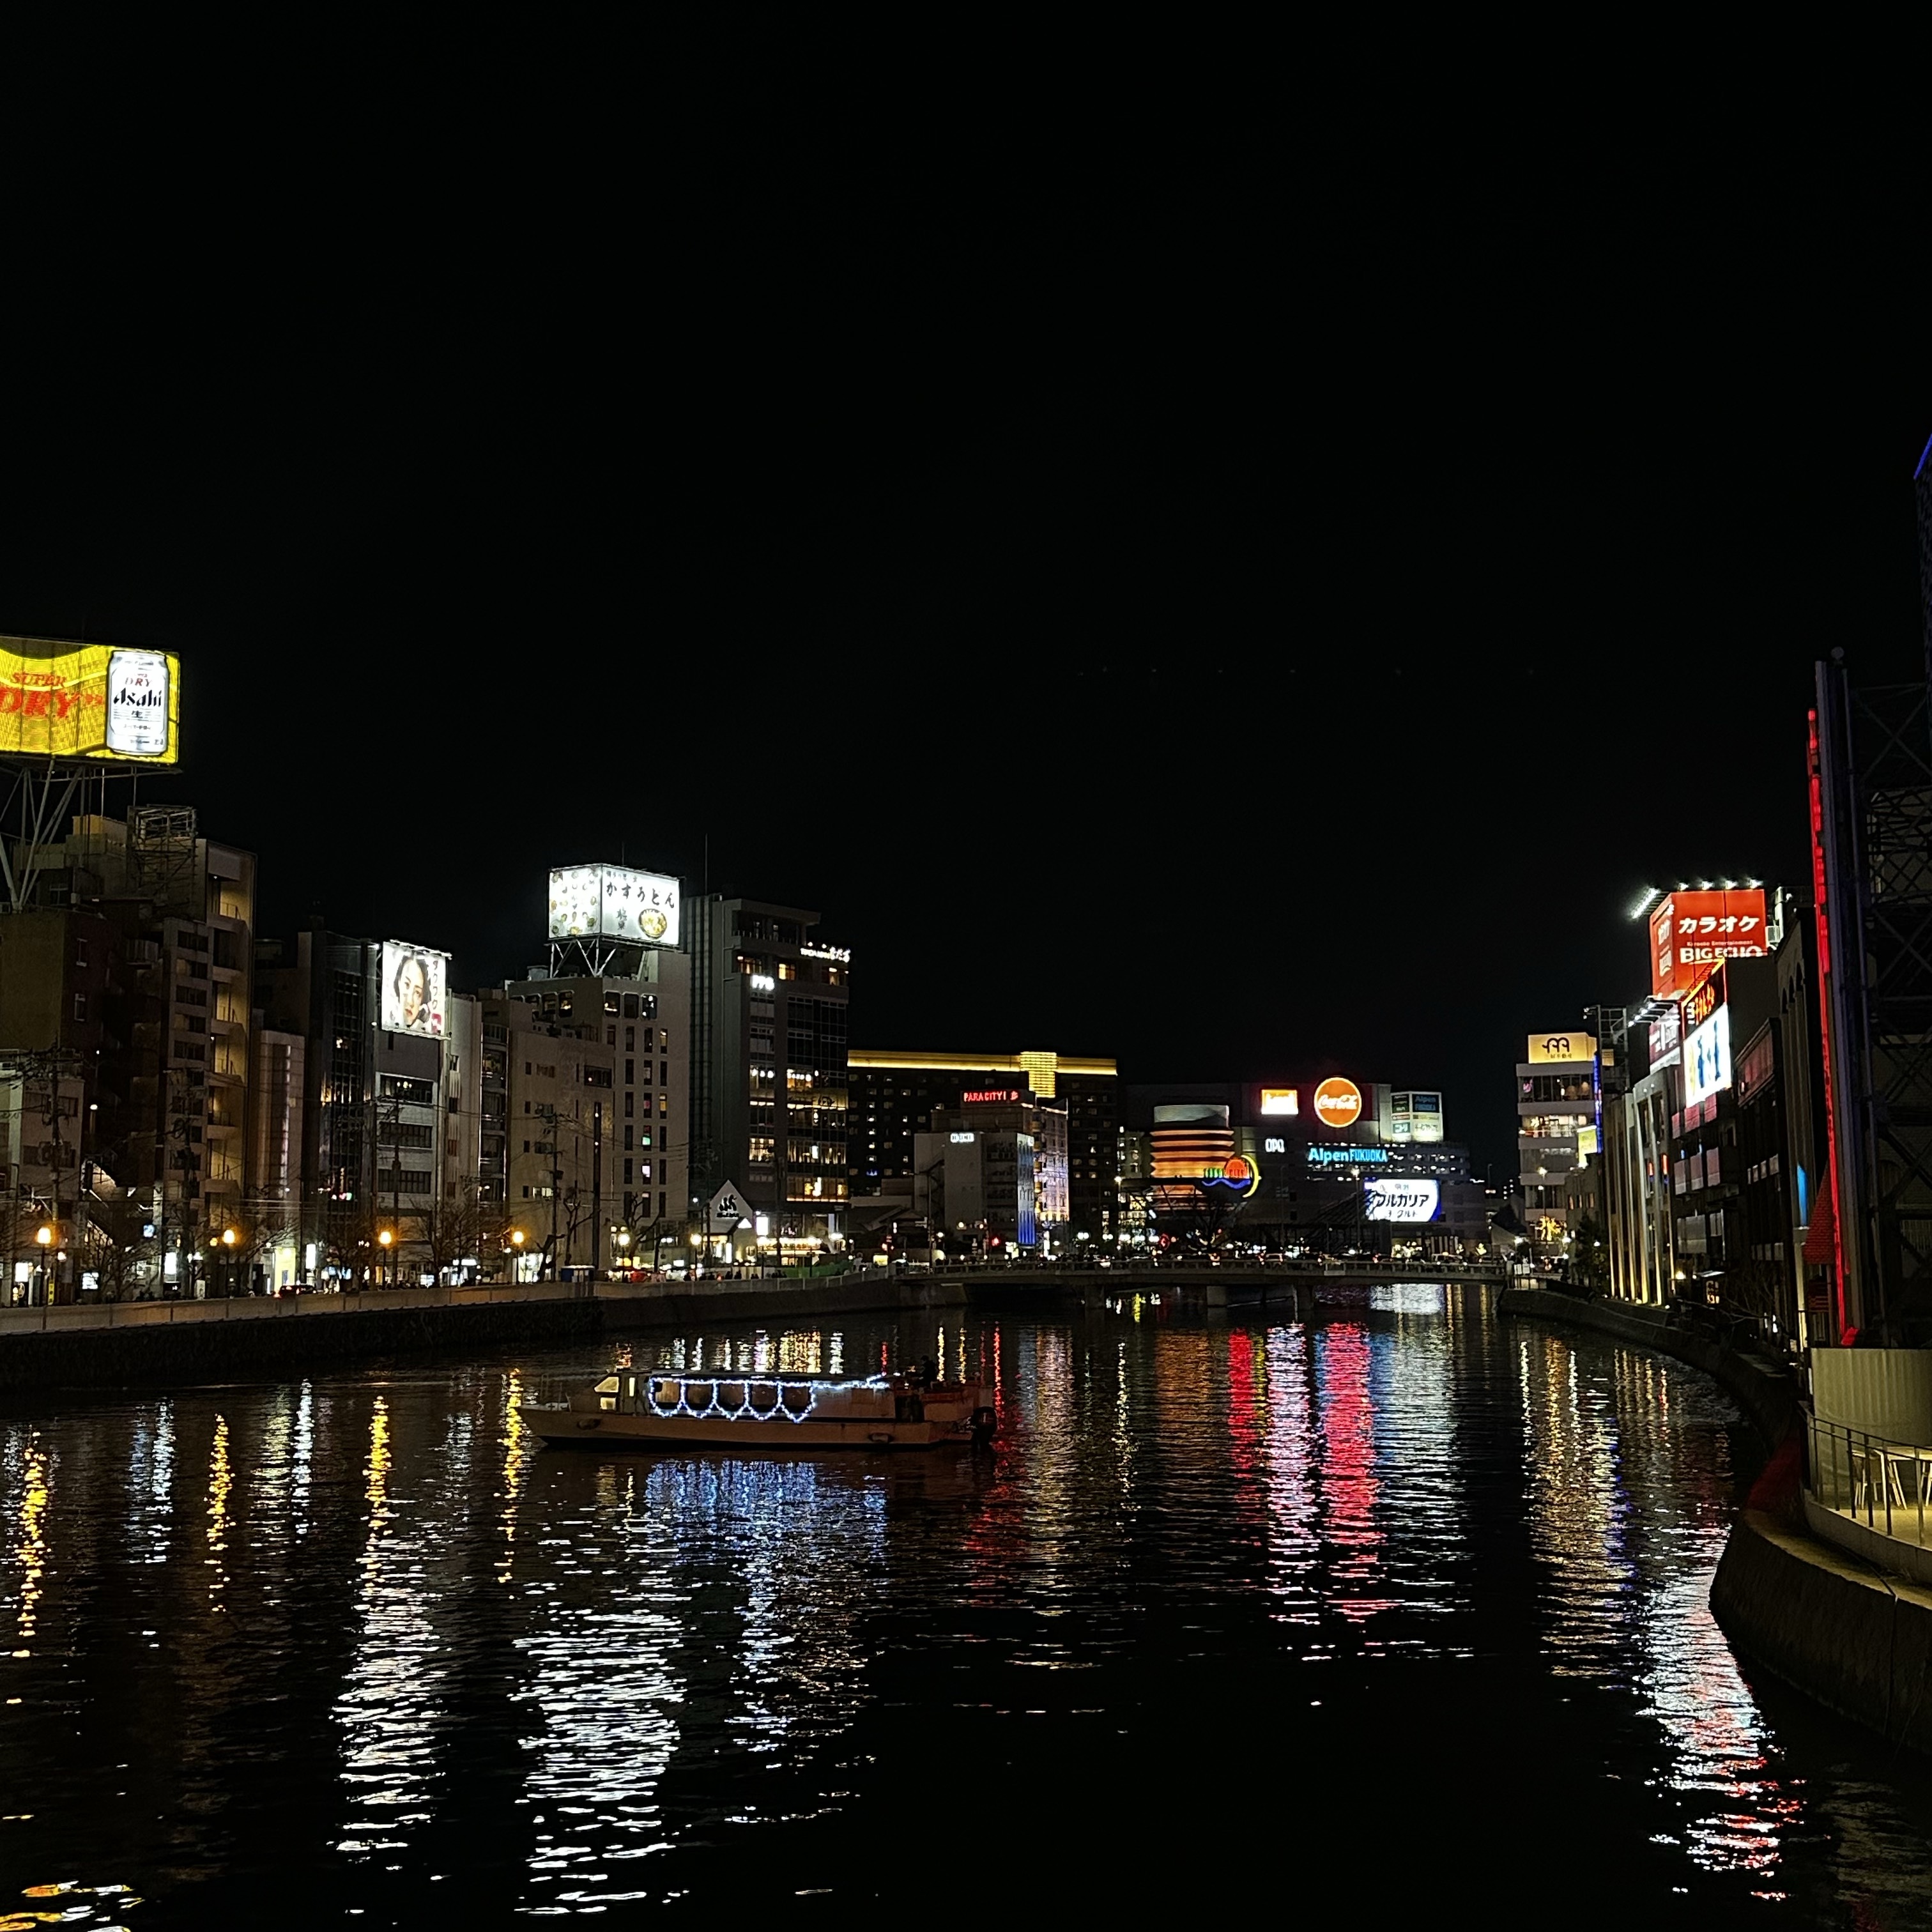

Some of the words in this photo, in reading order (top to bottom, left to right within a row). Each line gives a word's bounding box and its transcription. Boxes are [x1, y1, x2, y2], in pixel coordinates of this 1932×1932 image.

[113, 687, 162, 707] Asahi
[606, 881, 675, 908] かすうどん
[1678, 916, 1759, 933] カラオケ
[1680, 947, 1713, 963] BIG
[1308, 1148, 1349, 1166] Alpen
[1349, 1149, 1388, 1162] FUKUOKA
